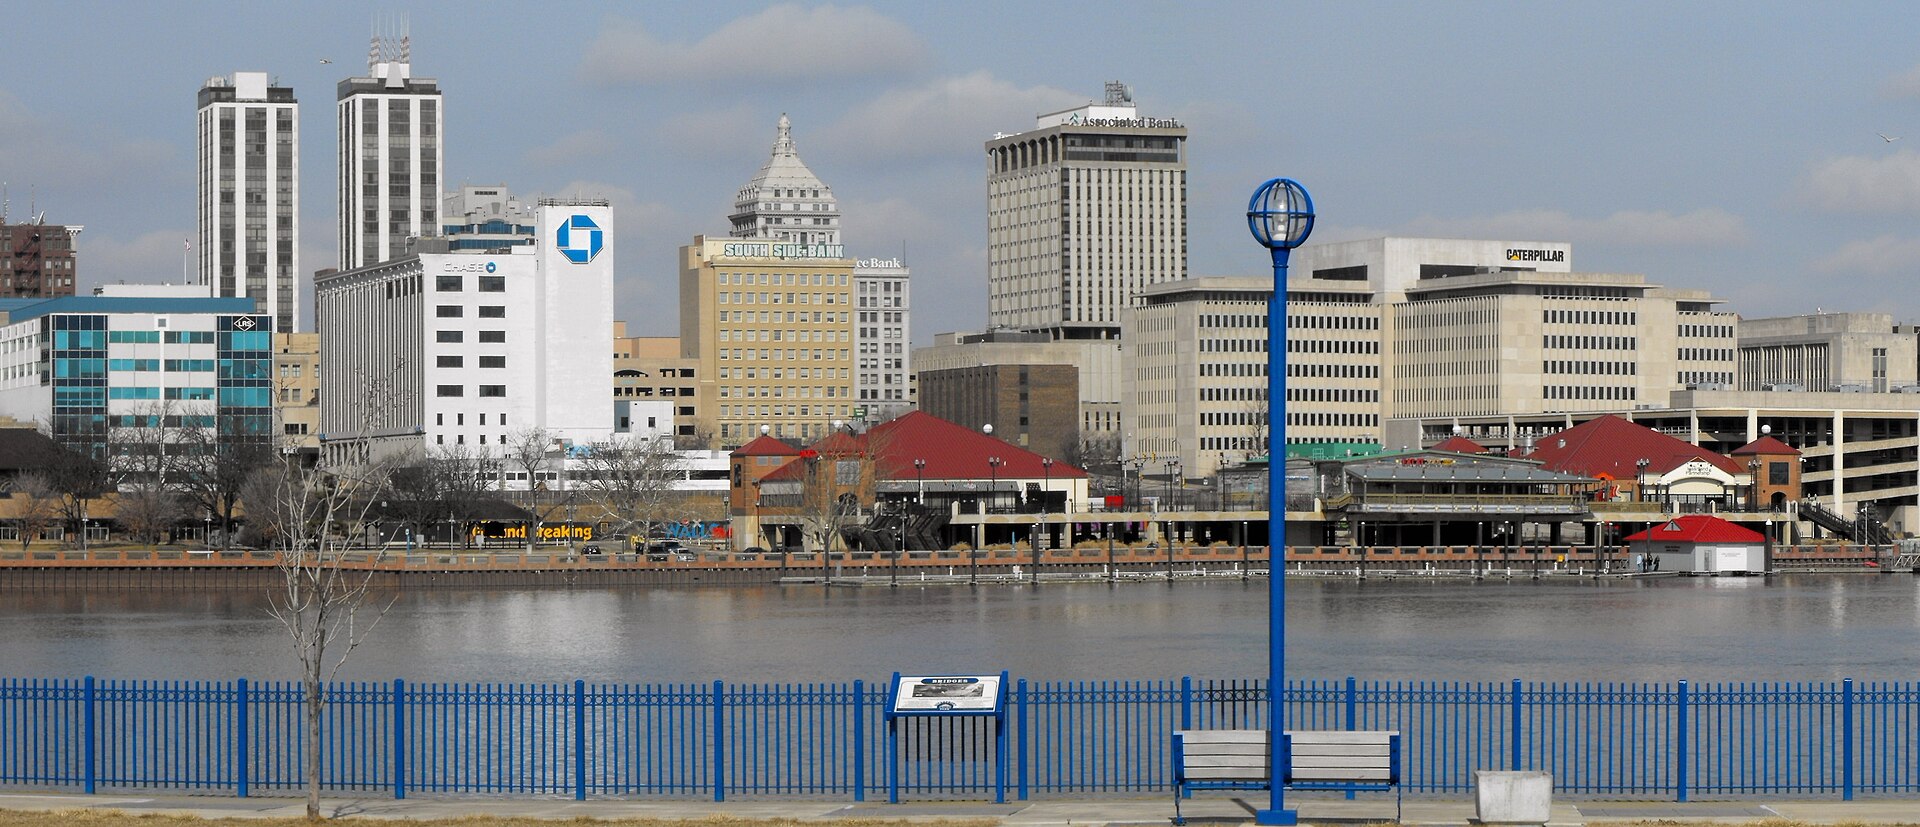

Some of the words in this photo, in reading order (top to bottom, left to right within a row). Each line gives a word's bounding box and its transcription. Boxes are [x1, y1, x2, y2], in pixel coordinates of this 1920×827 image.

[1081, 116, 1145, 128] Associated
[1147, 117, 1179, 129] Bank
[724, 243, 769, 258] SOUTH
[772, 244, 803, 259] SIDE
[807, 244, 844, 259] BANK
[1506, 248, 1564, 262] CATERPILLAR
[443, 262, 484, 273] CHASE
[870, 257, 901, 268] Bank
